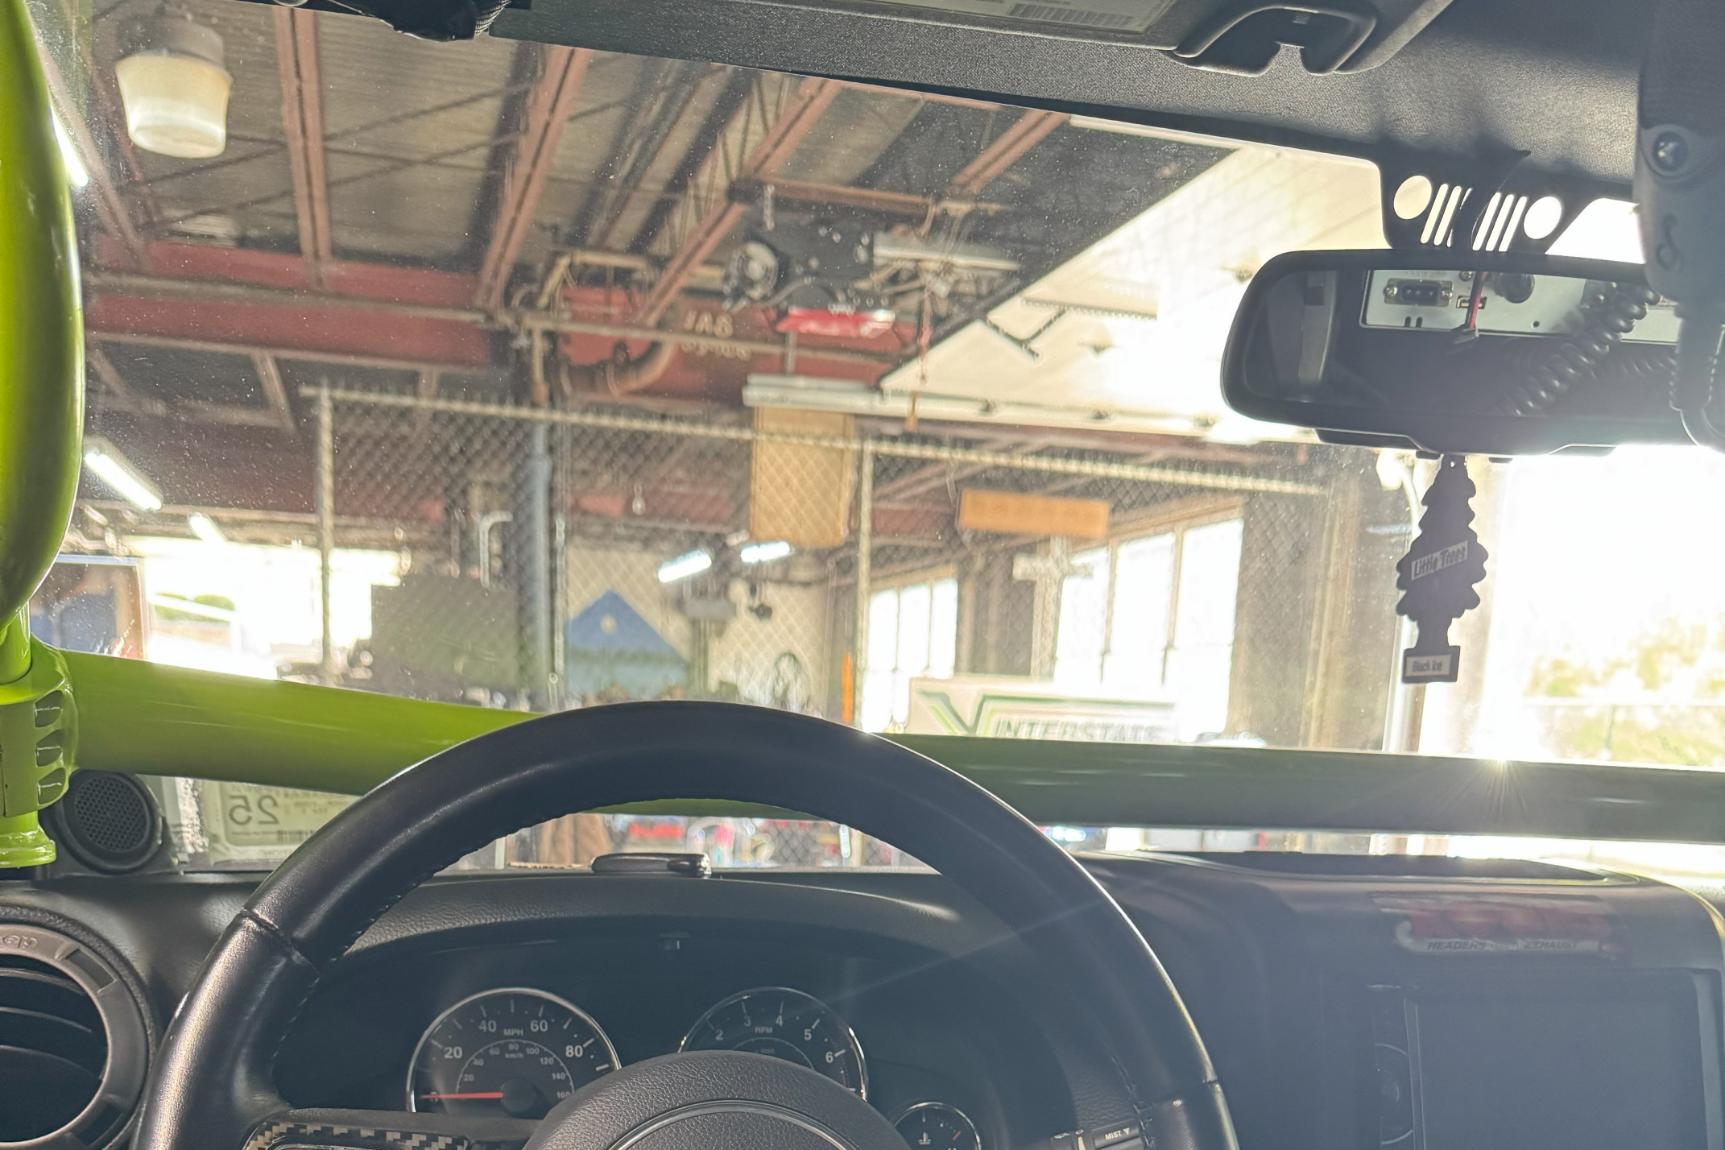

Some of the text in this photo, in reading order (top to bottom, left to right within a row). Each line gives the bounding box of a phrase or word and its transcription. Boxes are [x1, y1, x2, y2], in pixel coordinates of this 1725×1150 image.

[479, 1020, 497, 1033] 40
[530, 1020, 548, 1033] 60
[743, 1016, 752, 1028] 3
[775, 1015, 784, 1027] 4
[503, 1028, 524, 1036] MPH
[715, 1030, 724, 1041] 2
[754, 1026, 773, 1034] RPM
[803, 1029, 813, 1041] 5
[444, 1046, 463, 1059] 20
[526, 1047, 540, 1055] 100
[565, 1045, 583, 1058] 80
[473, 1058, 484, 1066] 40
[540, 1057, 554, 1065] 120
[824, 1051, 834, 1063] 6
[463, 1073, 475, 1082] 20
[551, 1072, 566, 1080] 140
[1104, 1130, 1121, 1140] MIST
